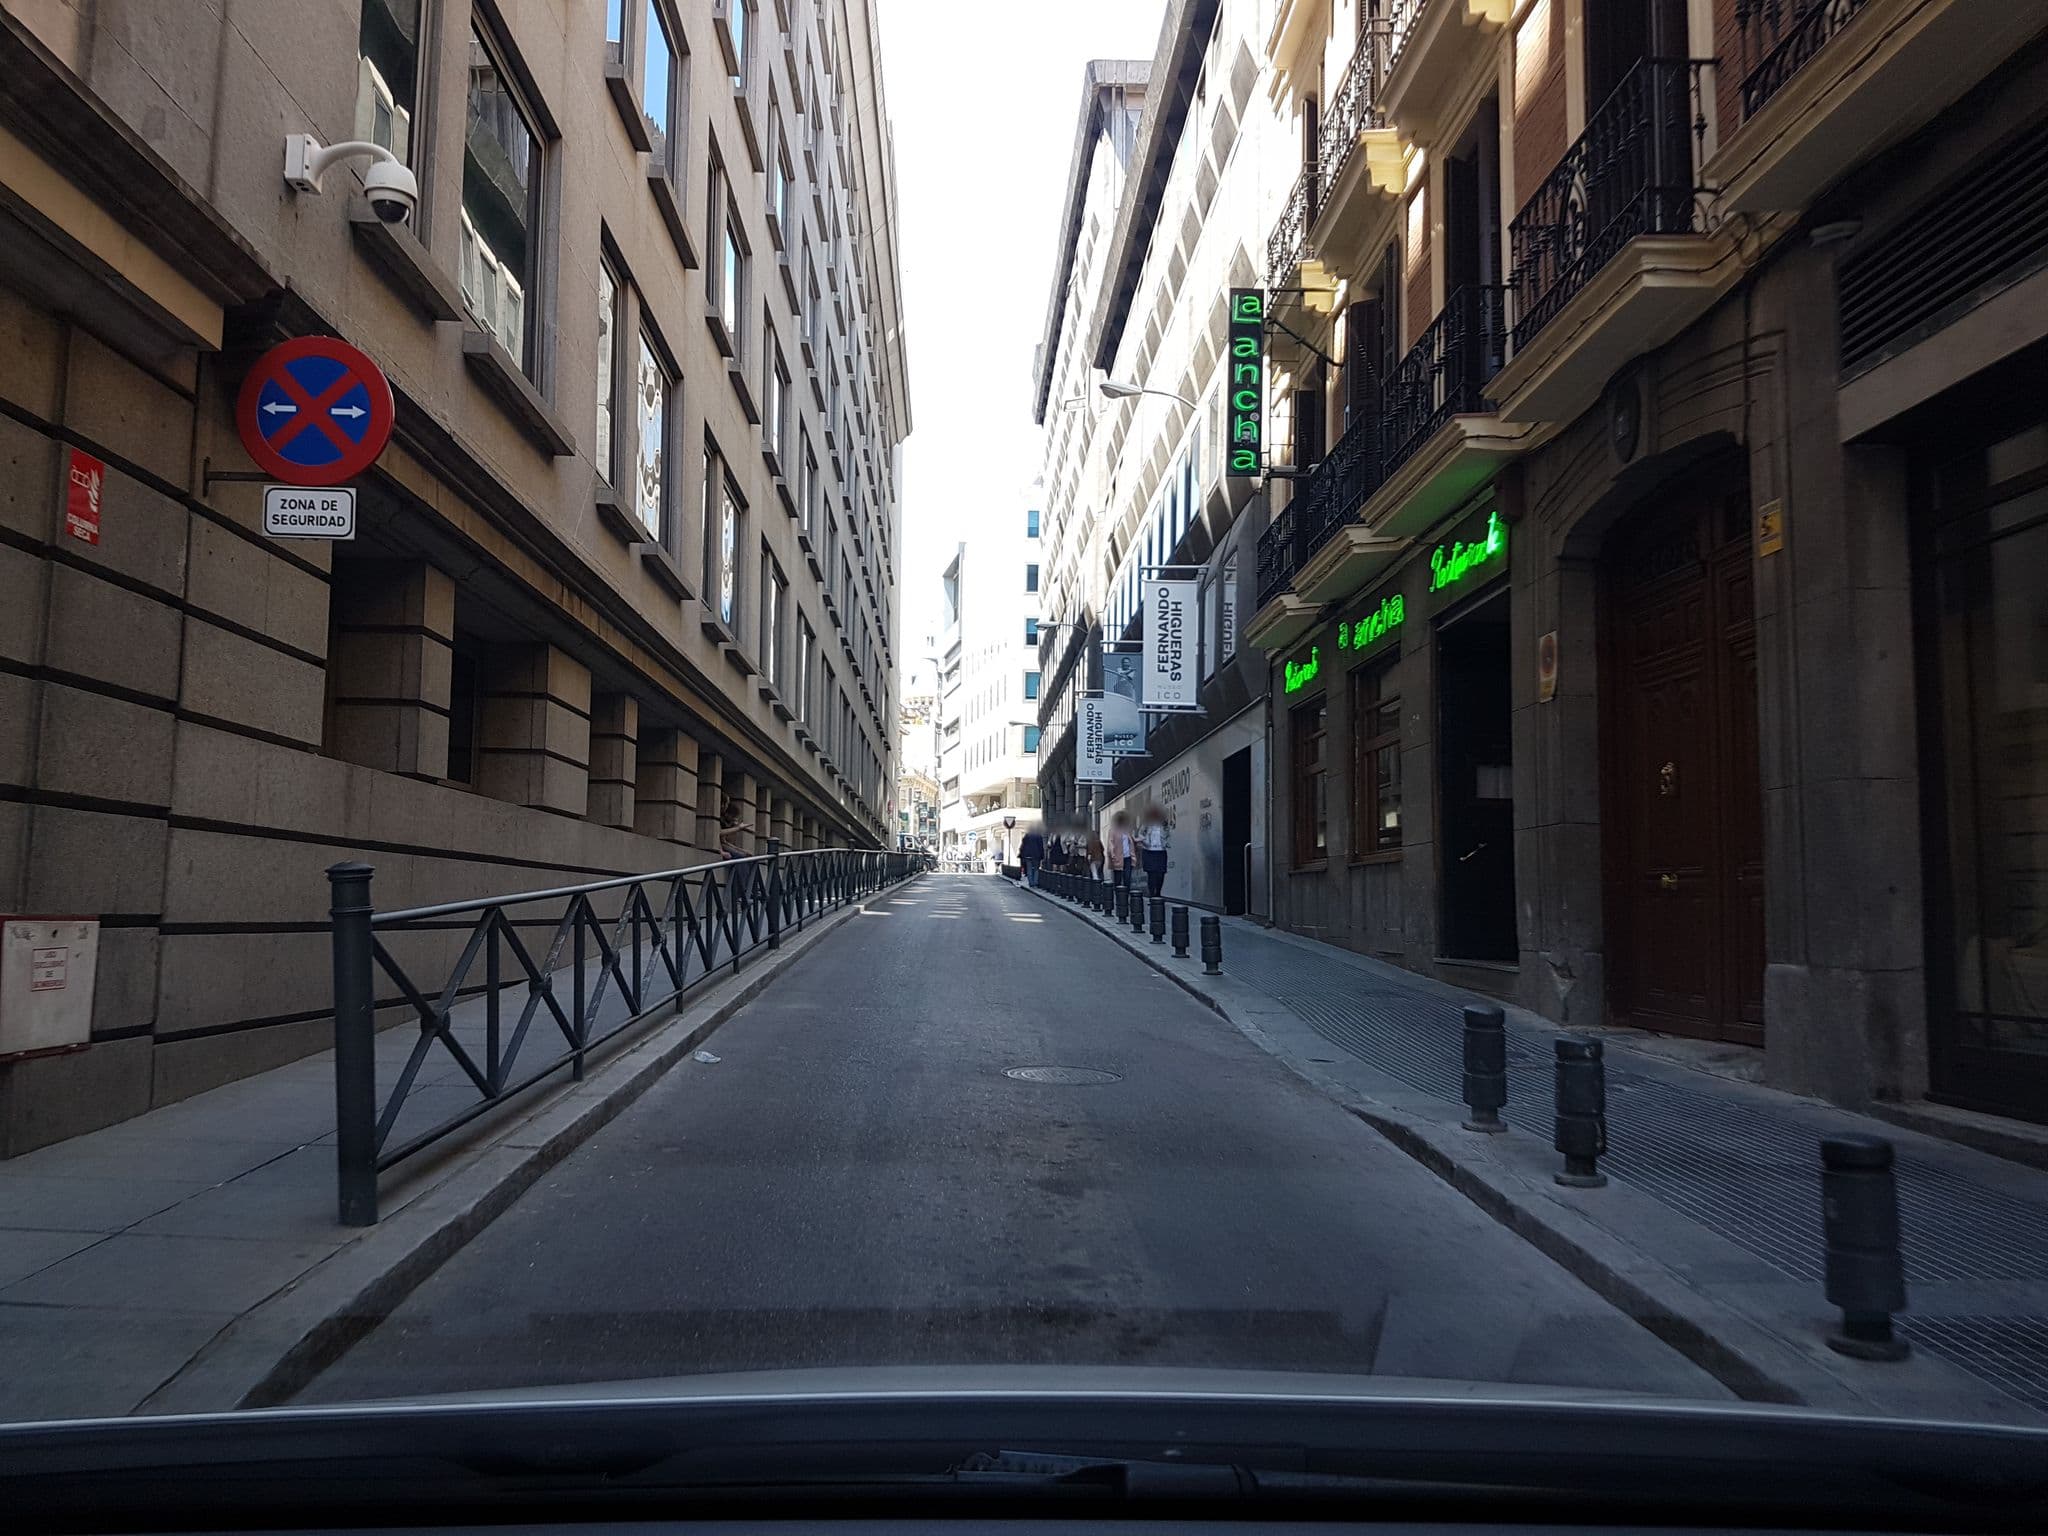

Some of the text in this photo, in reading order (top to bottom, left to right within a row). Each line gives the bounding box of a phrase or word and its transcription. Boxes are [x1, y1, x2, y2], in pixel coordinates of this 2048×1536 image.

[1232, 294, 1262, 471] La ancha
[271, 513, 346, 527] SEGURIDAD
[280, 499, 338, 511] ZONA DE
[1157, 587, 1170, 673] FERNANDO
[1170, 601, 1182, 682] HIGUERAS
[1157, 691, 1181, 700] ICO
[1086, 703, 1095, 759] FERNANDO
